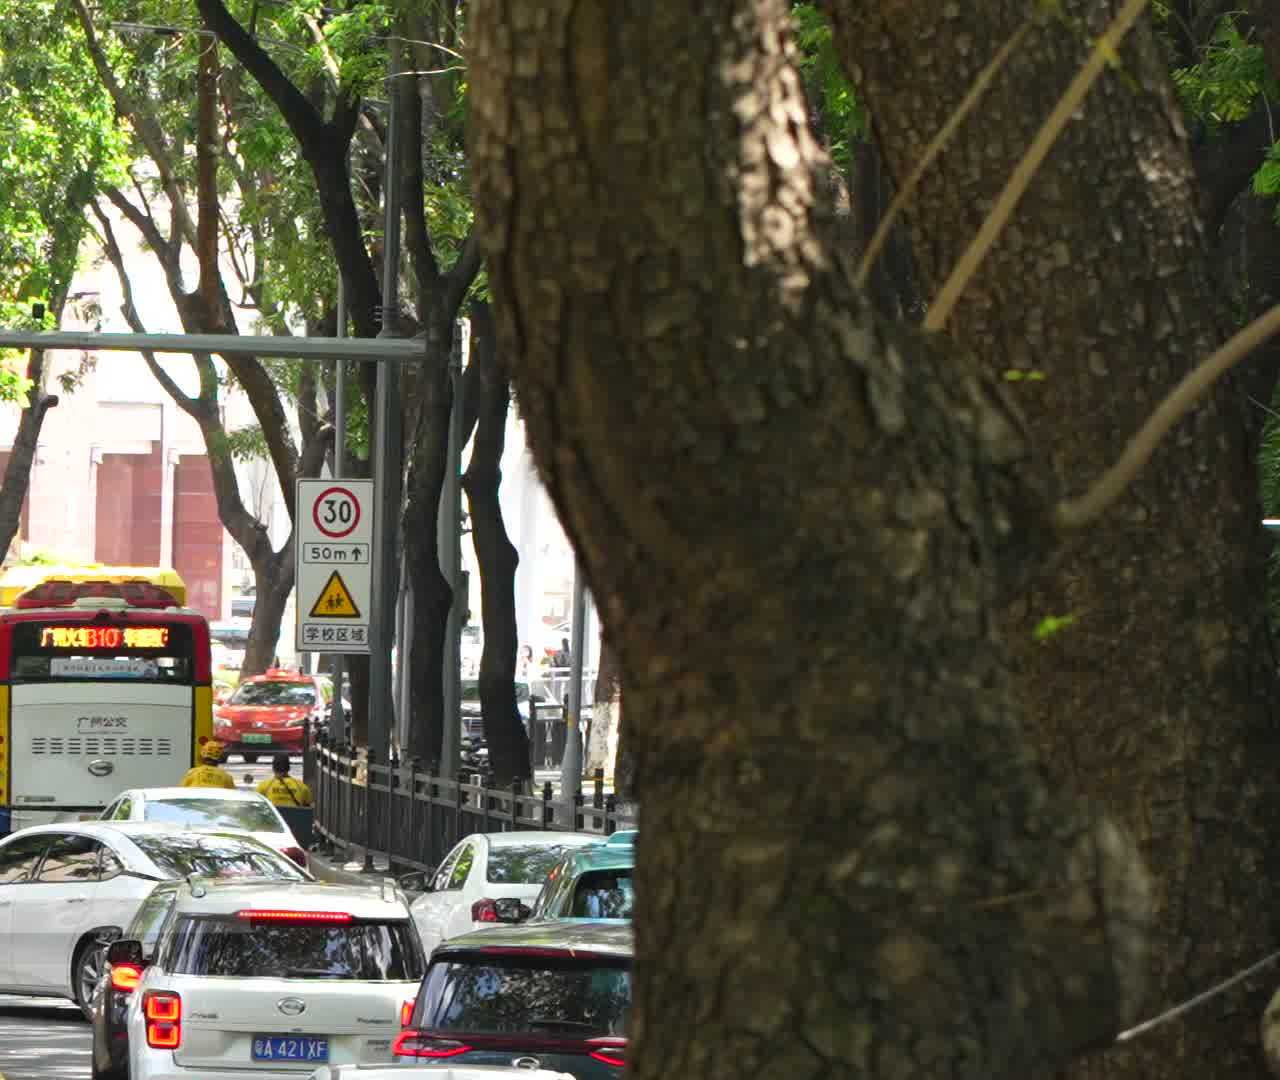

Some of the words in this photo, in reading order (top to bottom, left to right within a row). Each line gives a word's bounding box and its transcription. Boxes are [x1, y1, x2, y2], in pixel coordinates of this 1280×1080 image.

[323, 500, 352, 524] 30
[311, 547, 347, 561] 50m
[305, 628, 365, 643] 学校区域
